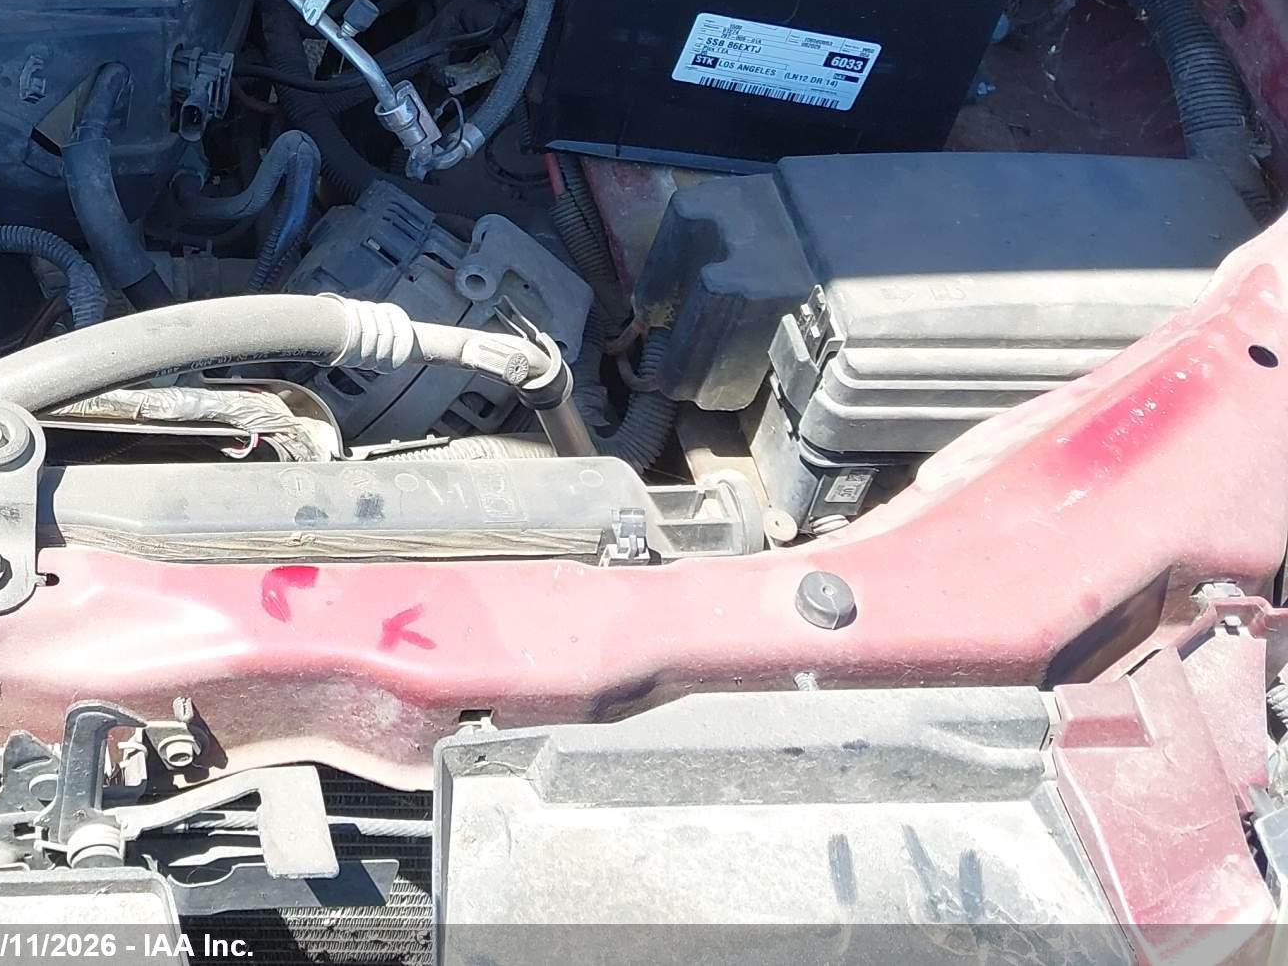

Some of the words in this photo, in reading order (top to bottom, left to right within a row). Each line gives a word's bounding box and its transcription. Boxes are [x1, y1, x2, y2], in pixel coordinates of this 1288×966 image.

[705, 37, 725, 47] SSB
[727, 40, 763, 54] 86EXTJ
[695, 55, 715, 66] STK
[718, 61, 735, 70] LOS
[737, 63, 777, 76] ANGELES
[810, 75, 823, 85] DR
[825, 79, 839, 89] 14)
[831, 56, 864, 71] 6033
